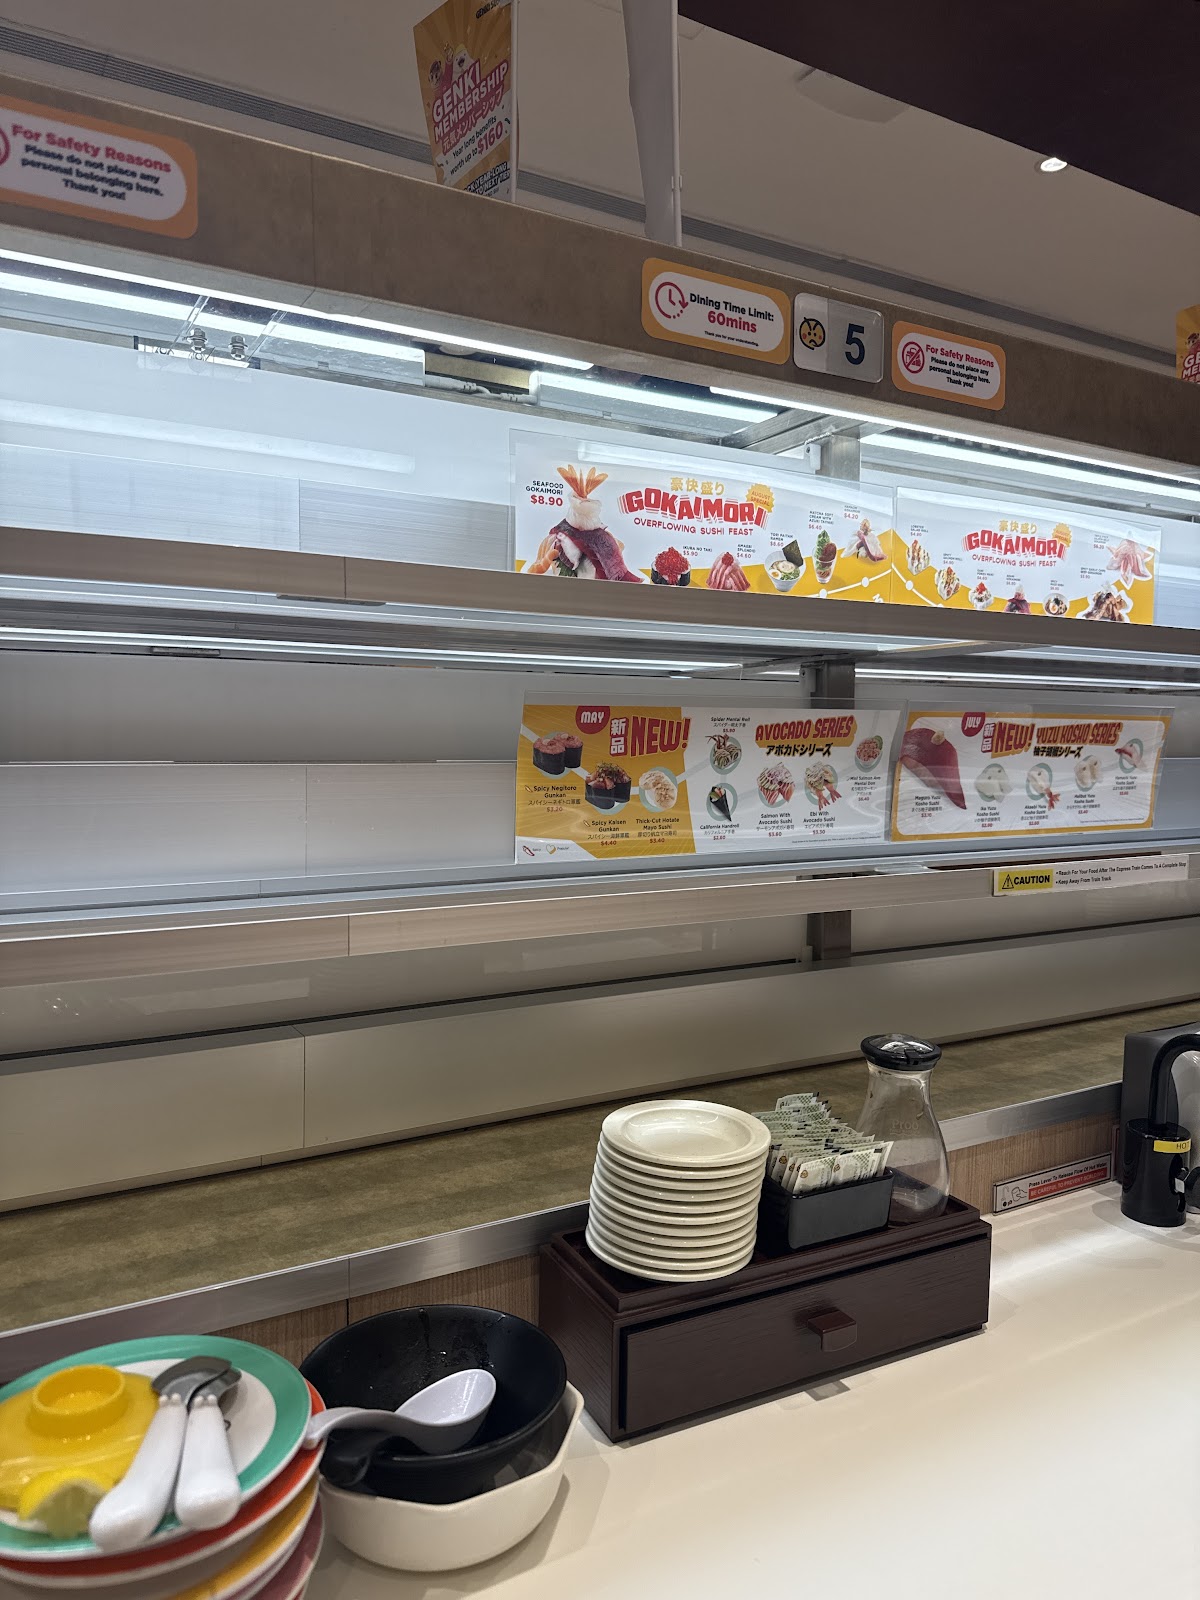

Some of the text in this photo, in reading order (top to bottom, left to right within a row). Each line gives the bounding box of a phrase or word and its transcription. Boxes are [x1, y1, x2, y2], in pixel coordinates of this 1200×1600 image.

[433, 62, 480, 122] GENKI
[435, 62, 508, 141] MEMBERSHIP
[11, 124, 172, 172] For Safety Reasons
[450, 120, 504, 175] worth up to $160
[453, 116, 497, 158] Year long benefits
[25, 144, 160, 184] Please do not place any
[21, 158, 164, 196] personal belonging here.
[63, 178, 126, 200] Thank you!
[690, 292, 774, 322] Dining Time Limit:
[708, 310, 757, 333] 60mins
[845, 322, 866, 366] 5
[926, 344, 994, 368] For Safety Reasons
[930, 356, 948, 366] Please
[956, 362, 965, 370] not
[966, 364, 980, 374] place
[929, 365, 952, 375] personal
[952, 370, 978, 382] belonging
[946, 376, 962, 386] Thank
[526, 486, 564, 496] GOKAIMORI
[532, 480, 564, 489] SEAFOOD
[670, 477, 725, 496] 豪快盛り
[530, 494, 564, 507] $8.90
[625, 487, 764, 527] GOKAIMORI
[634, 517, 754, 536] OVERFLOWING SUSHI FEAST
[998, 520, 1037, 534] 豪快盛り
[967, 530, 1064, 558] GOKAIMORI
[972, 554, 1016, 566] OVERFLOWING
[580, 712, 604, 724] MAY
[755, 715, 854, 742] AVOCADO SERIES
[965, 716, 982, 730] JULY
[610, 718, 626, 754] 新品
[630, 716, 692, 757] NEW!
[982, 724, 995, 750] 新品
[994, 722, 1121, 752] NEW! YUZU KOSHO SERIES
[766, 742, 834, 757] アボカドシリーズ
[1014, 874, 1050, 886] CAUTION
[1038, 1184, 1058, 1194] CAREFUL
[1064, 1177, 1084, 1187] PREVENT
